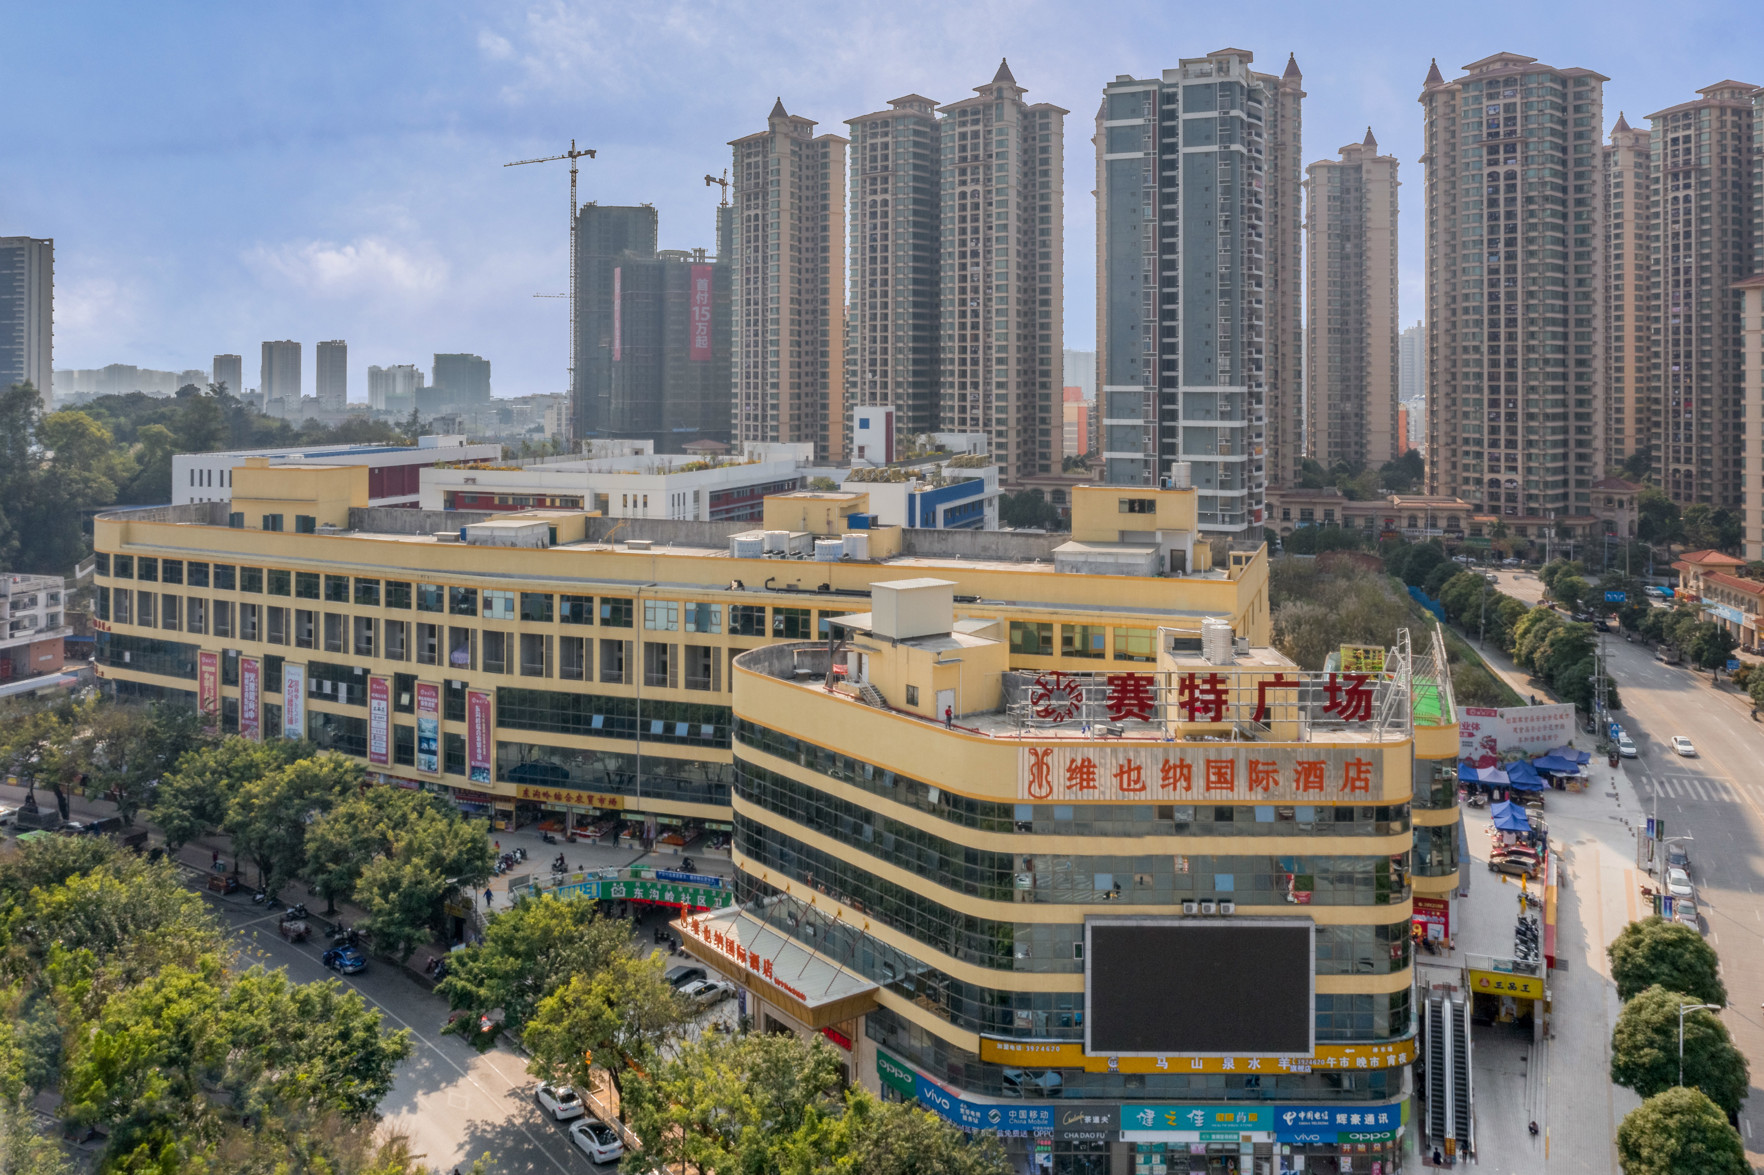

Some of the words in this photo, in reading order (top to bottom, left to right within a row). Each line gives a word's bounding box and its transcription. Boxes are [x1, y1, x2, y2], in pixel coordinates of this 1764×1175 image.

[692, 278, 711, 348] 首付15万起
[1106, 672, 1373, 723] 赛特广场
[1065, 757, 1374, 793] 维也纳国际酒店
[1493, 981, 1531, 993] 三品王
[1156, 1056, 1290, 1070] 马山泉水羊
[1326, 1056, 1350, 1068] 午市
[1356, 1056, 1380, 1068] 晚市
[879, 1059, 912, 1083] oppo
[924, 1087, 950, 1110] vivo
[1009, 1110, 1049, 1119] 中国移动
[1136, 1109, 1205, 1127] 健之佳
[1298, 1110, 1329, 1120] 中国电信
[1336, 1113, 1389, 1125] 辉豪通讯
[1294, 1133, 1320, 1141] vivo
[1349, 1132, 1390, 1141] oppo
